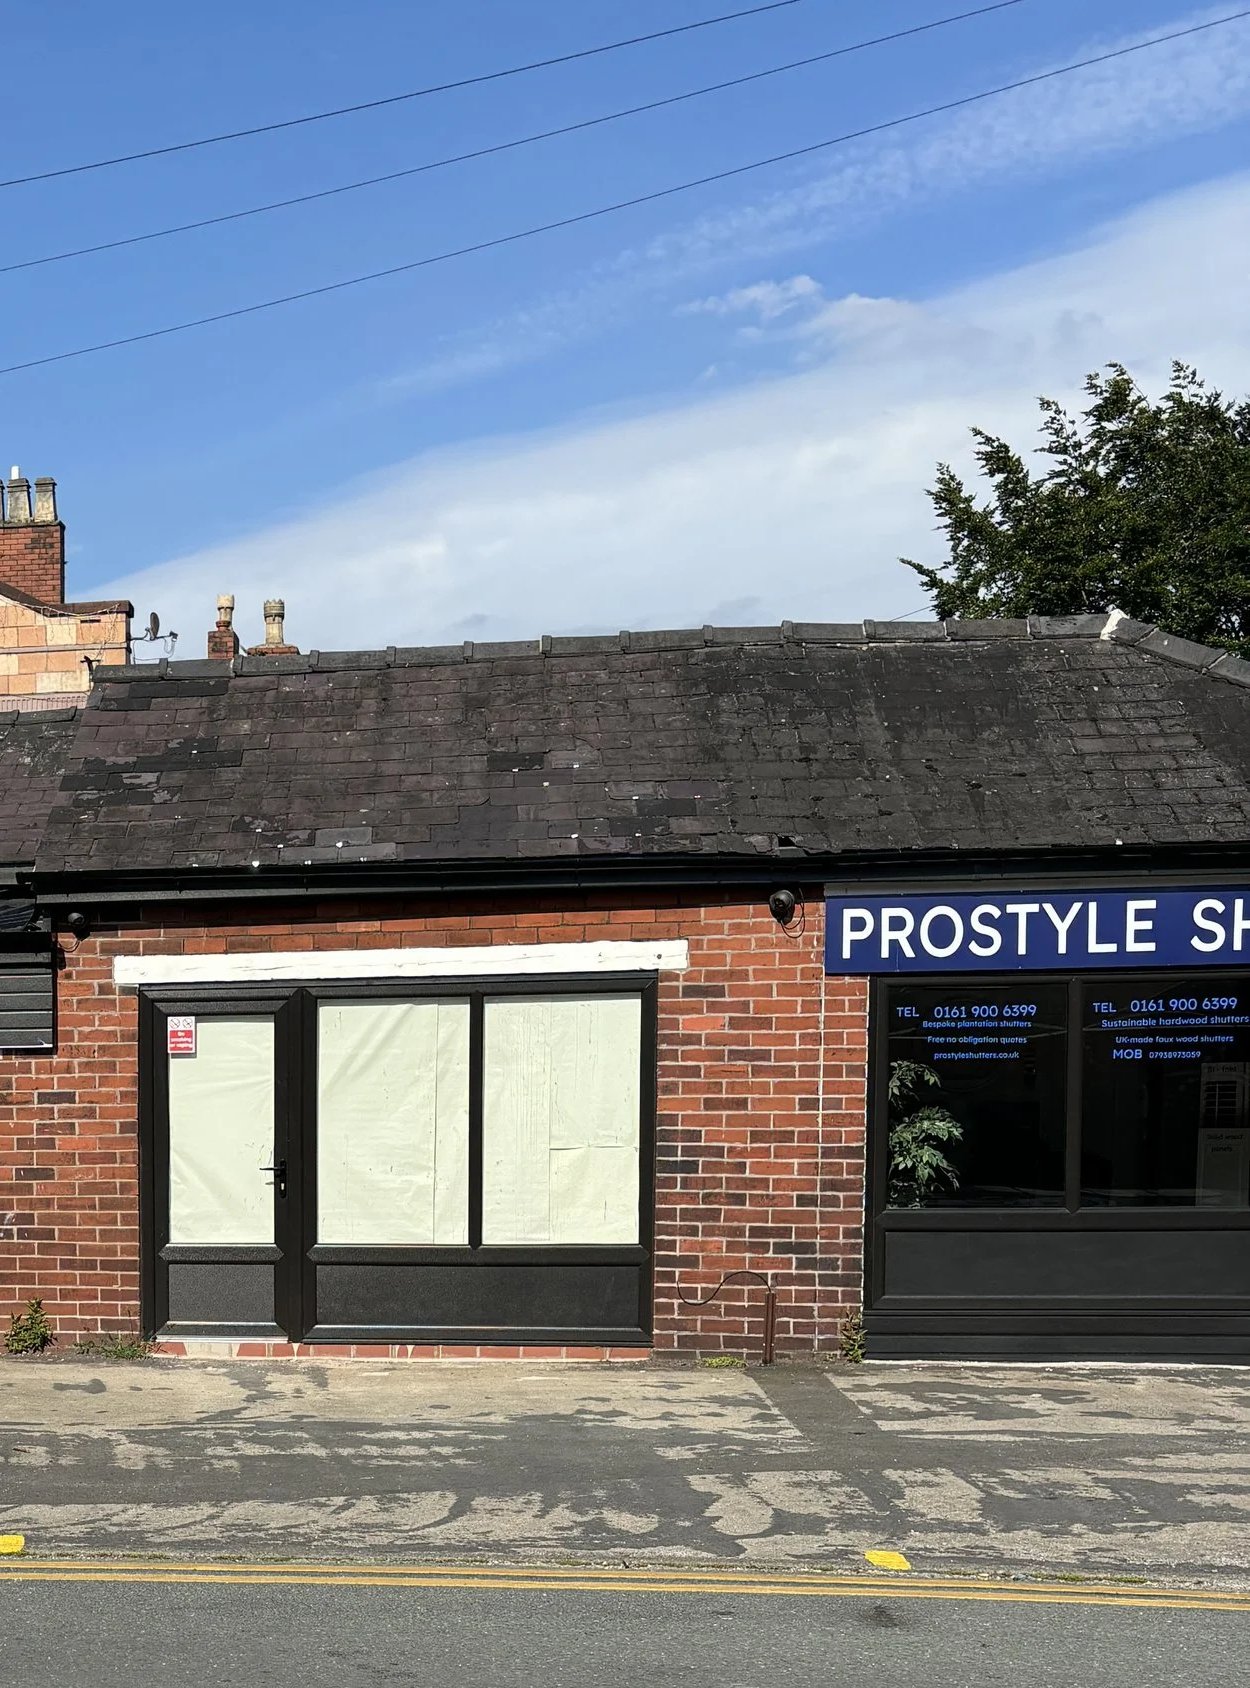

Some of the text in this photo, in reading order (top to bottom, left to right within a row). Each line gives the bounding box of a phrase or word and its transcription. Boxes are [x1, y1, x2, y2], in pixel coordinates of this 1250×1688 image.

[841, 899, 1157, 960] PROSTYLE
[1092, 997, 1238, 1013] TEL 0161 900 6399
[896, 1004, 1037, 1019] TEL 0161 900 6399
[922, 1020, 1032, 1029] Bespoke plantation shutters
[1101, 1014, 1250, 1028] Sustainable hardwood shutters
[927, 1035, 1028, 1045] Free no obligation quotes
[1155, 1035, 1174, 1043] faux
[1175, 1034, 1199, 1043] wood
[1200, 1034, 1235, 1043] shutters
[934, 1051, 1020, 1060] prostyleshutters.co.uk
[1112, 1048, 1143, 1060] MOB
